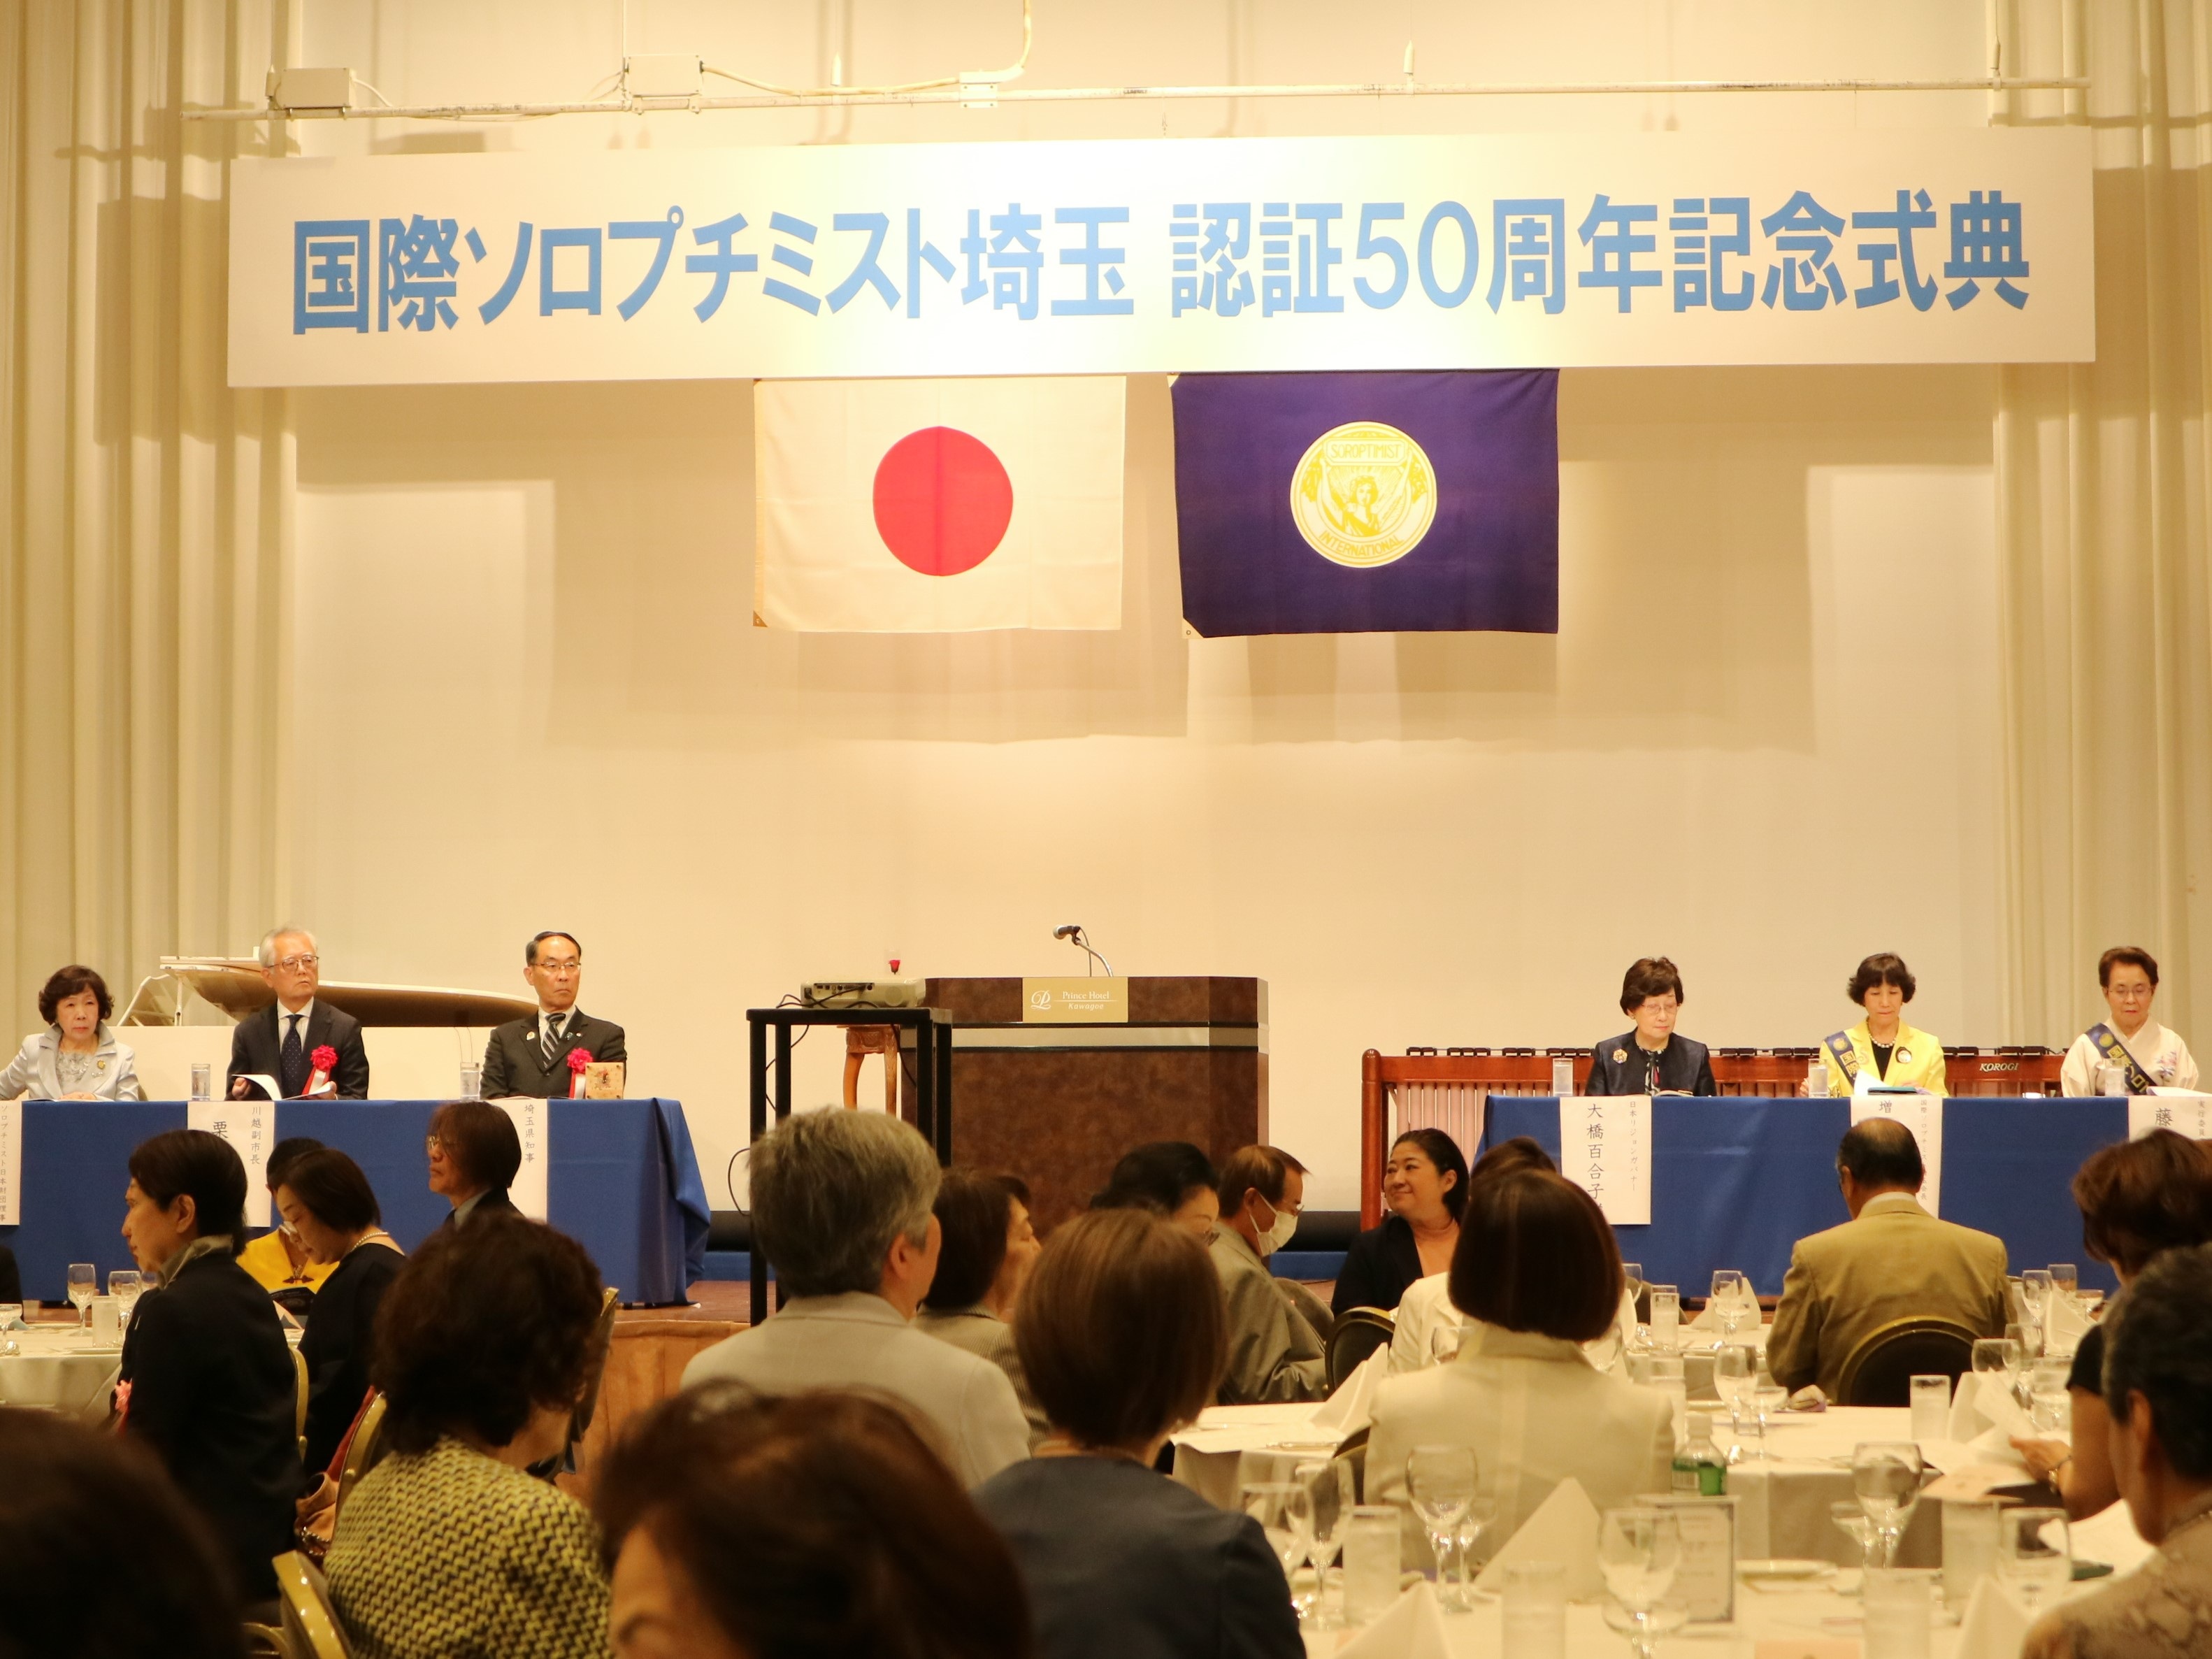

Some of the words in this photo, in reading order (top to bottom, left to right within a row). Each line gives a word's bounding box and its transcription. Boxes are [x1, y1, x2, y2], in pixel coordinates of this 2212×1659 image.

[294, 203, 1135, 334] 国際ソロプチミスト埼玉
[1169, 189, 2029, 318] 認証50周年記念式典
[1330, 443, 1402, 459] SOROPTIMIST
[1319, 531, 1404, 556] INTERNATIONAL
[1062, 991, 1086, 1000] Prince
[1089, 991, 1109, 1000] Hotel
[1068, 1003, 1104, 1011] Kawagoe
[1979, 1063, 2019, 1072] KOROGI
[1879, 1099, 1893, 1114] 増
[2155, 1107, 2174, 1126] 藤
[212, 1121, 229, 1139] 栗
[250, 1106, 262, 1165] 川越副市長
[524, 1103, 536, 1163] 埼玉県知事
[1629, 1101, 1639, 1192] 日本リジョンガバナー
[1586, 1103, 1604, 1213] 大橋百合子
